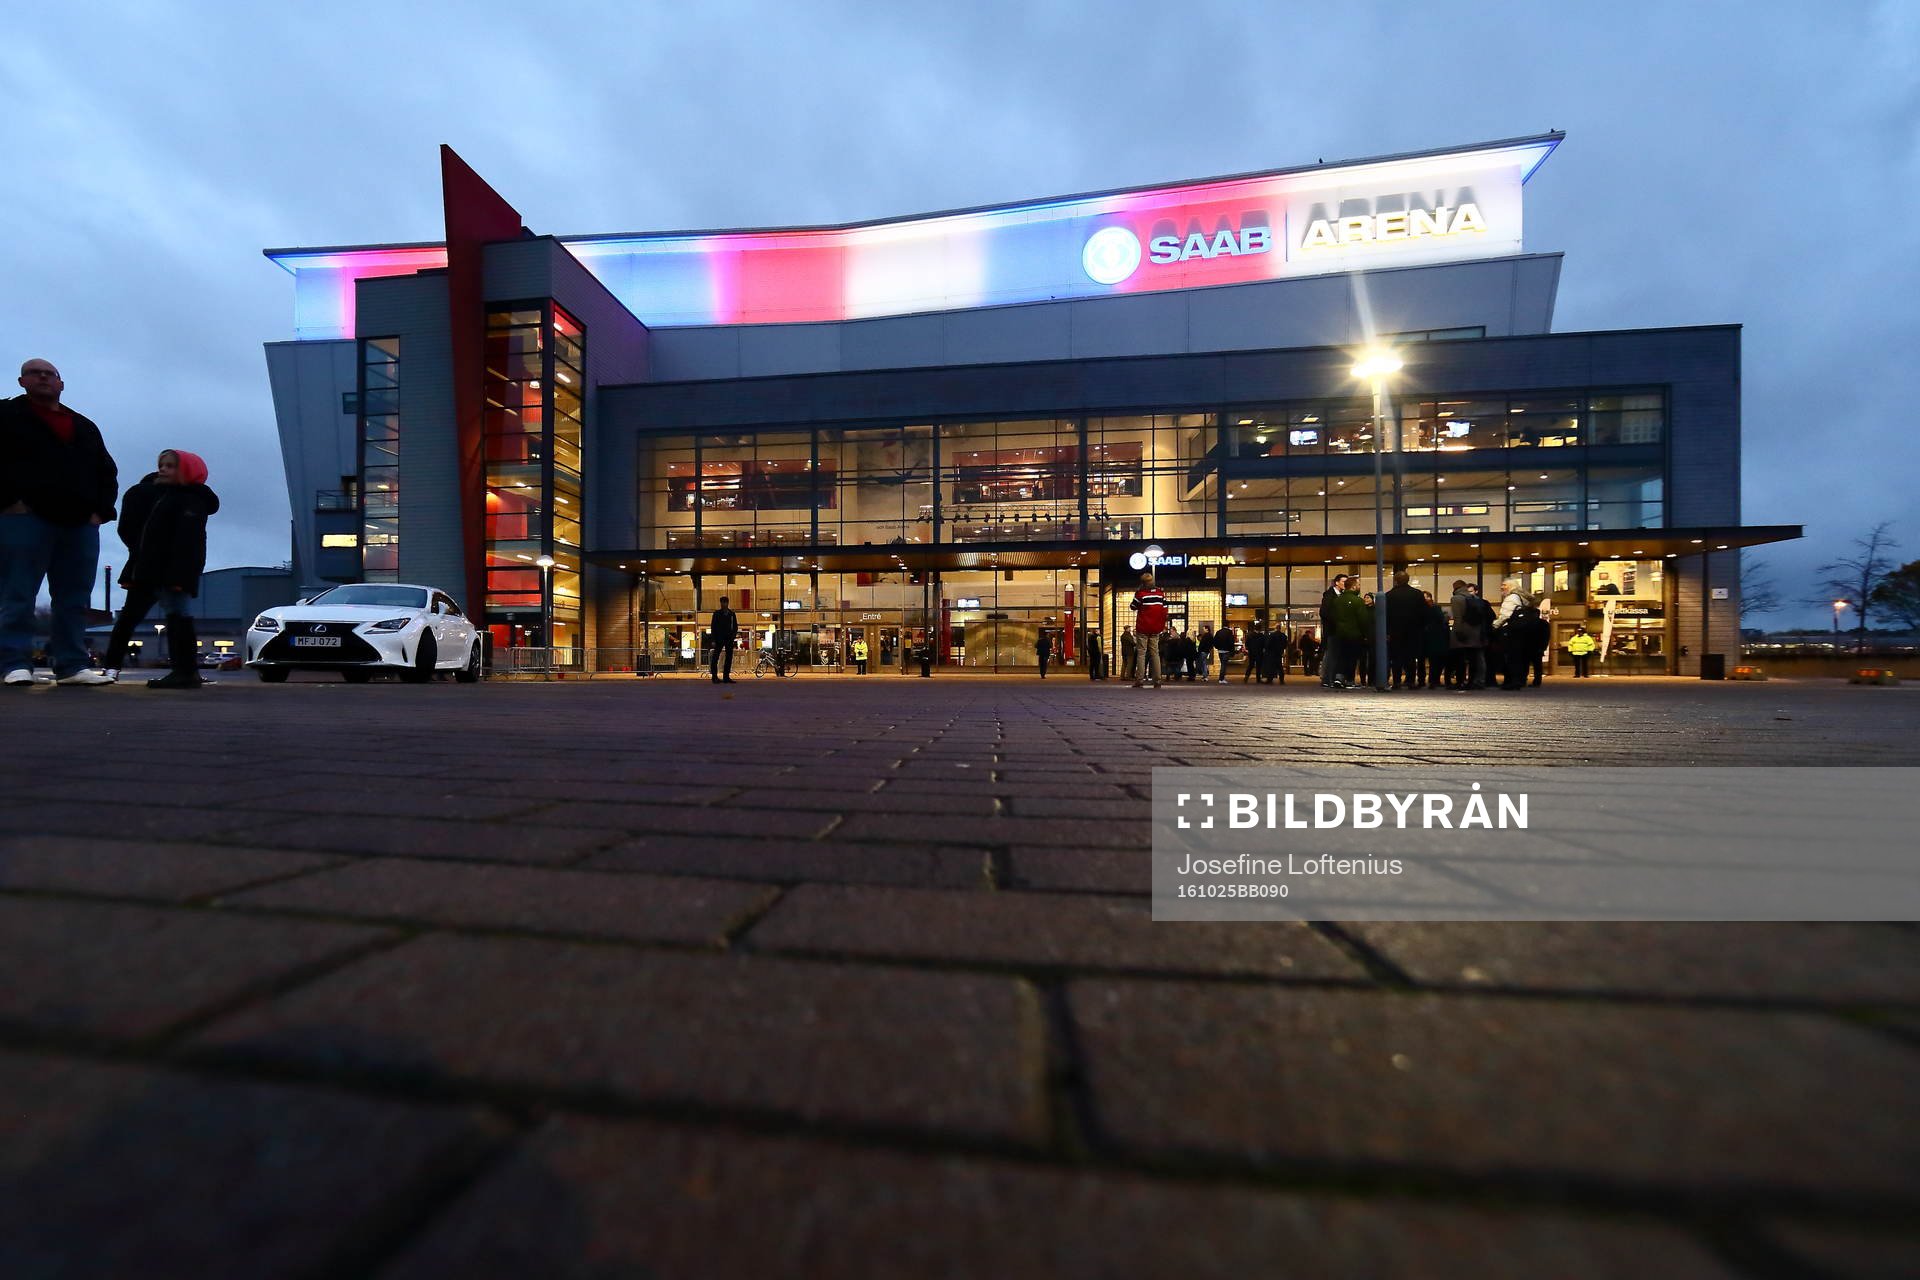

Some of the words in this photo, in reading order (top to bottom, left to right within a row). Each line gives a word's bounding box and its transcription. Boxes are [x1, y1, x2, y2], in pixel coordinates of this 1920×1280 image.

[1149, 226, 1272, 265] SAAB
[1300, 203, 1488, 249] ARENA
[1148, 556, 1183, 566] SAAB
[1188, 555, 1236, 566] ARENA
[862, 612, 881, 620] Entré
[297, 637, 317, 646] MFJ
[318, 637, 338, 646] 072
